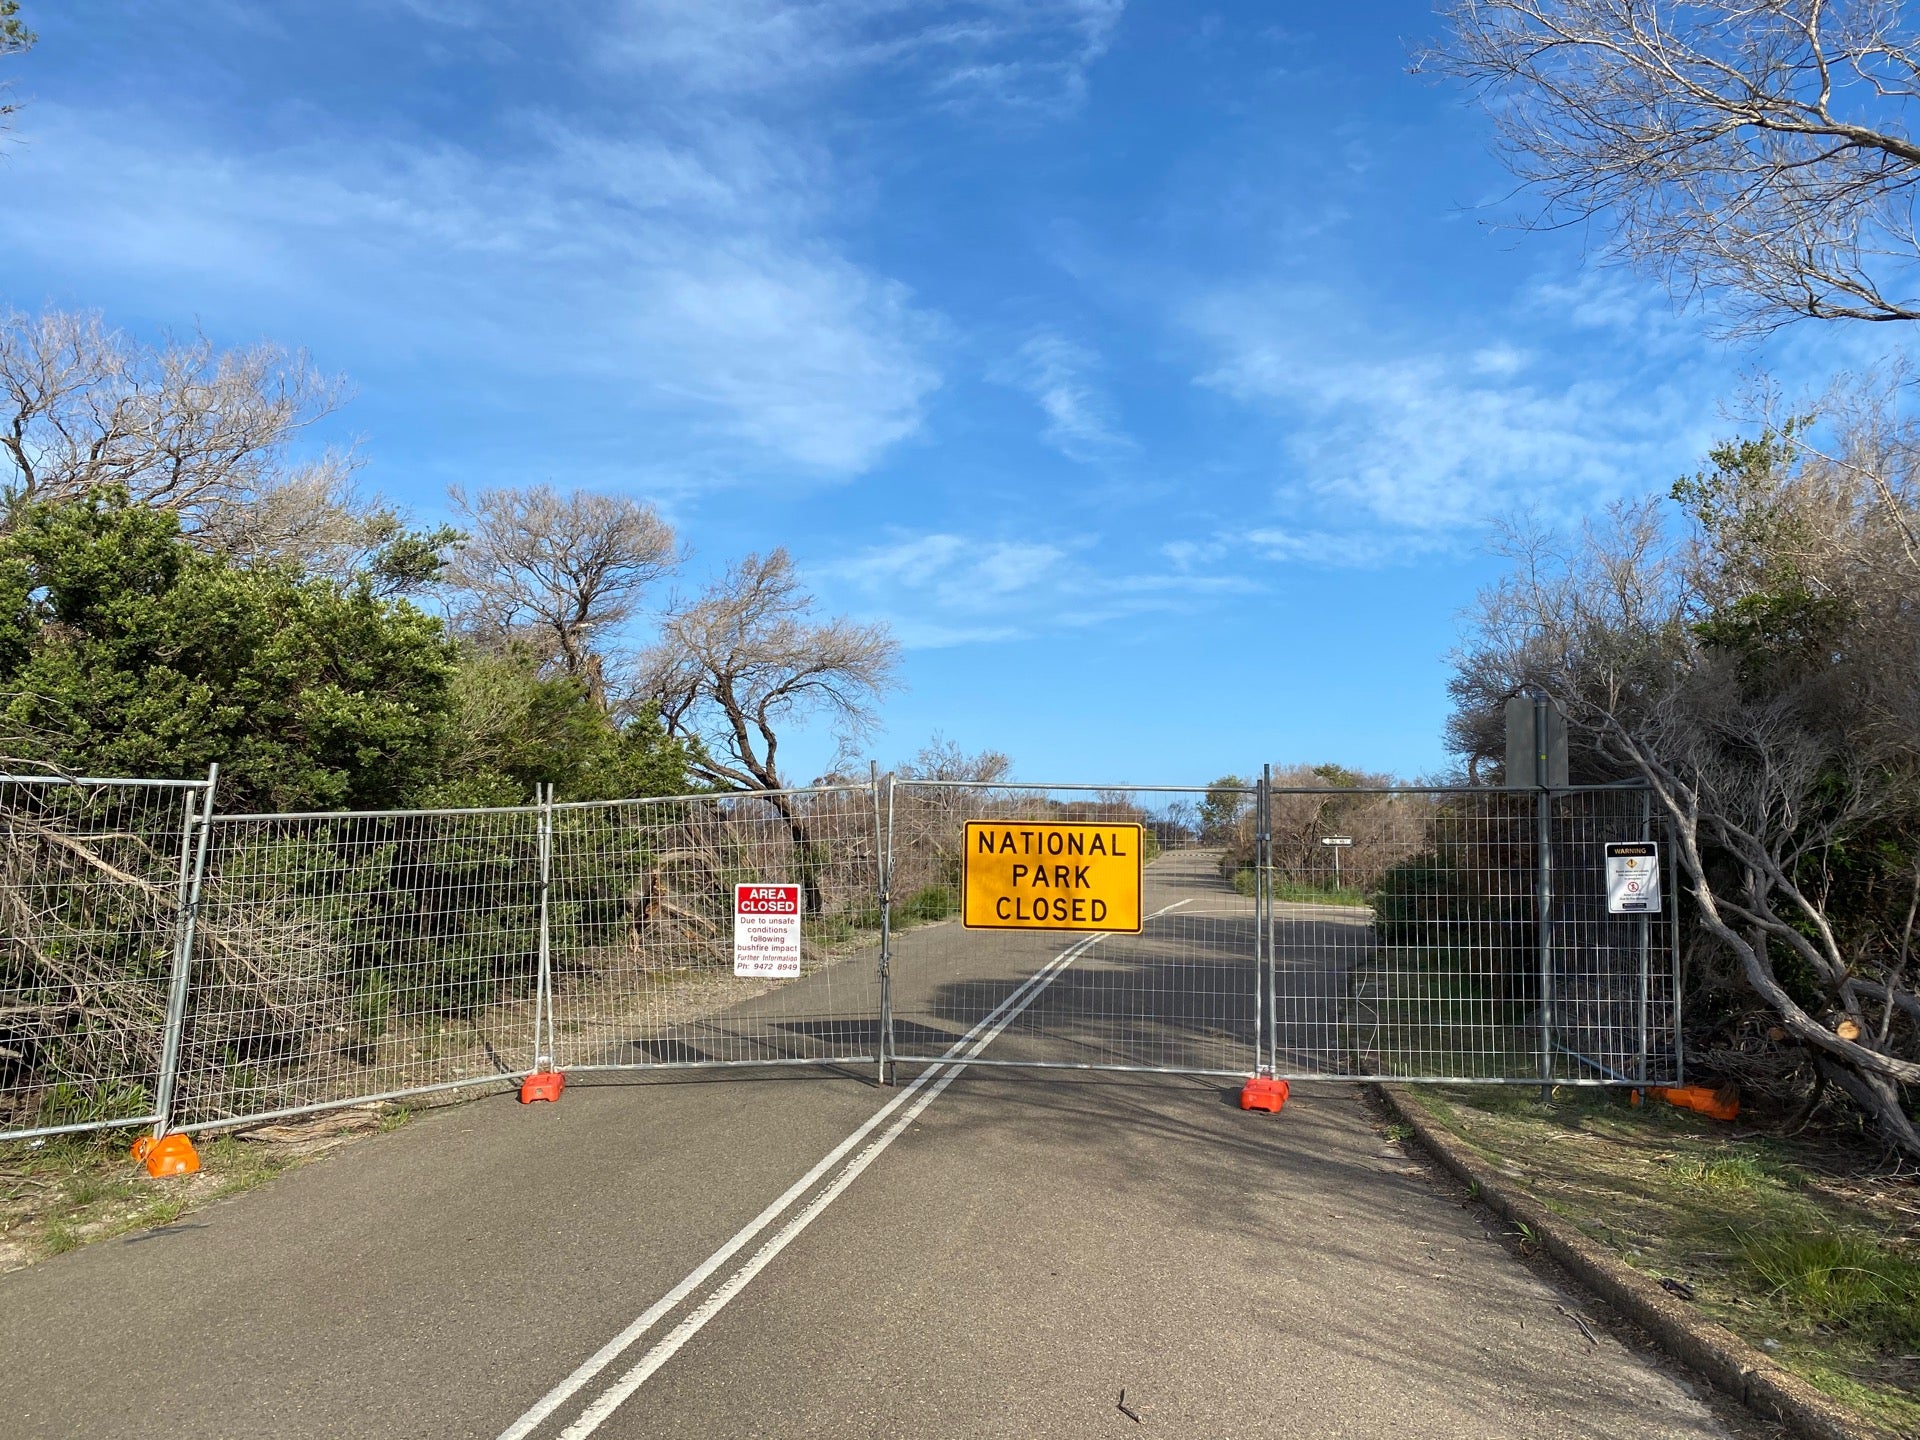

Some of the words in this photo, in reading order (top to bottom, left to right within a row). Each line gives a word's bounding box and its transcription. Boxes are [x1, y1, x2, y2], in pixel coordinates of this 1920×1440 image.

[978, 831, 1126, 856] NATIONAL
[1012, 864, 1091, 888] PARK
[749, 889, 786, 899] AREA
[741, 901, 795, 912] CLOSED
[996, 896, 1107, 922] CLOSED
[750, 936, 785, 944] following
[771, 945, 797, 953] impact
